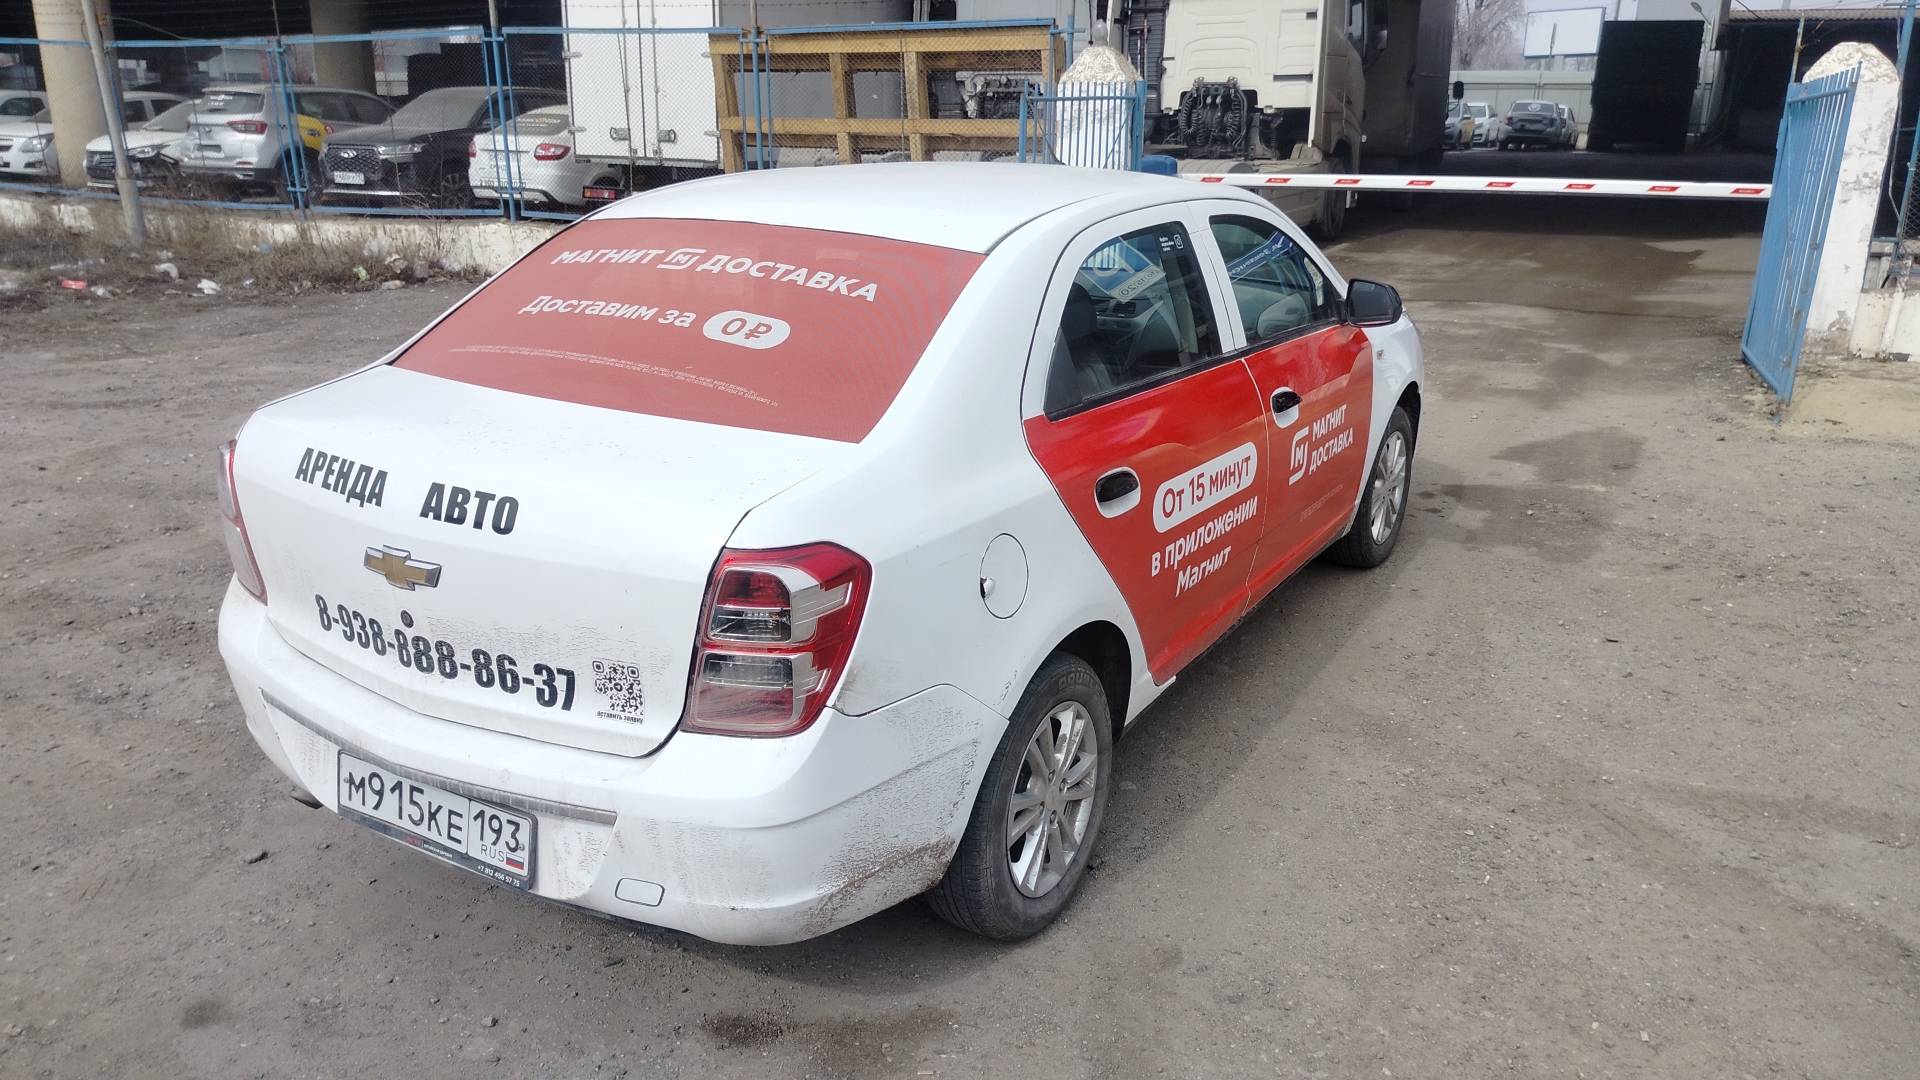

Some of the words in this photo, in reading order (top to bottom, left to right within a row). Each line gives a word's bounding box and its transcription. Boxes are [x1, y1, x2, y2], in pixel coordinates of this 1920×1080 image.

[551, 247, 664, 266] МАГНИТ
[698, 254, 879, 302] ДОСТАВКА
[519, 294, 657, 322] Доставим
[658, 308, 697, 327] за
[1312, 404, 1346, 441] МАГНИТ
[1309, 427, 1354, 475] ДОСТАВКА
[295, 447, 388, 507] АРЕНДА
[419, 482, 519, 535] АВТО
[1162, 487, 1185, 519] От
[1189, 472, 1205, 505] 15
[1209, 456, 1252, 496] минут
[1152, 551, 1161, 577] в
[1164, 495, 1258, 571] приложении
[1175, 546, 1231, 598] Магнит
[314, 594, 575, 711] 8-938-888-86-37
[473, 809, 521, 853] 193
[480, 843, 505, 862] RUS
